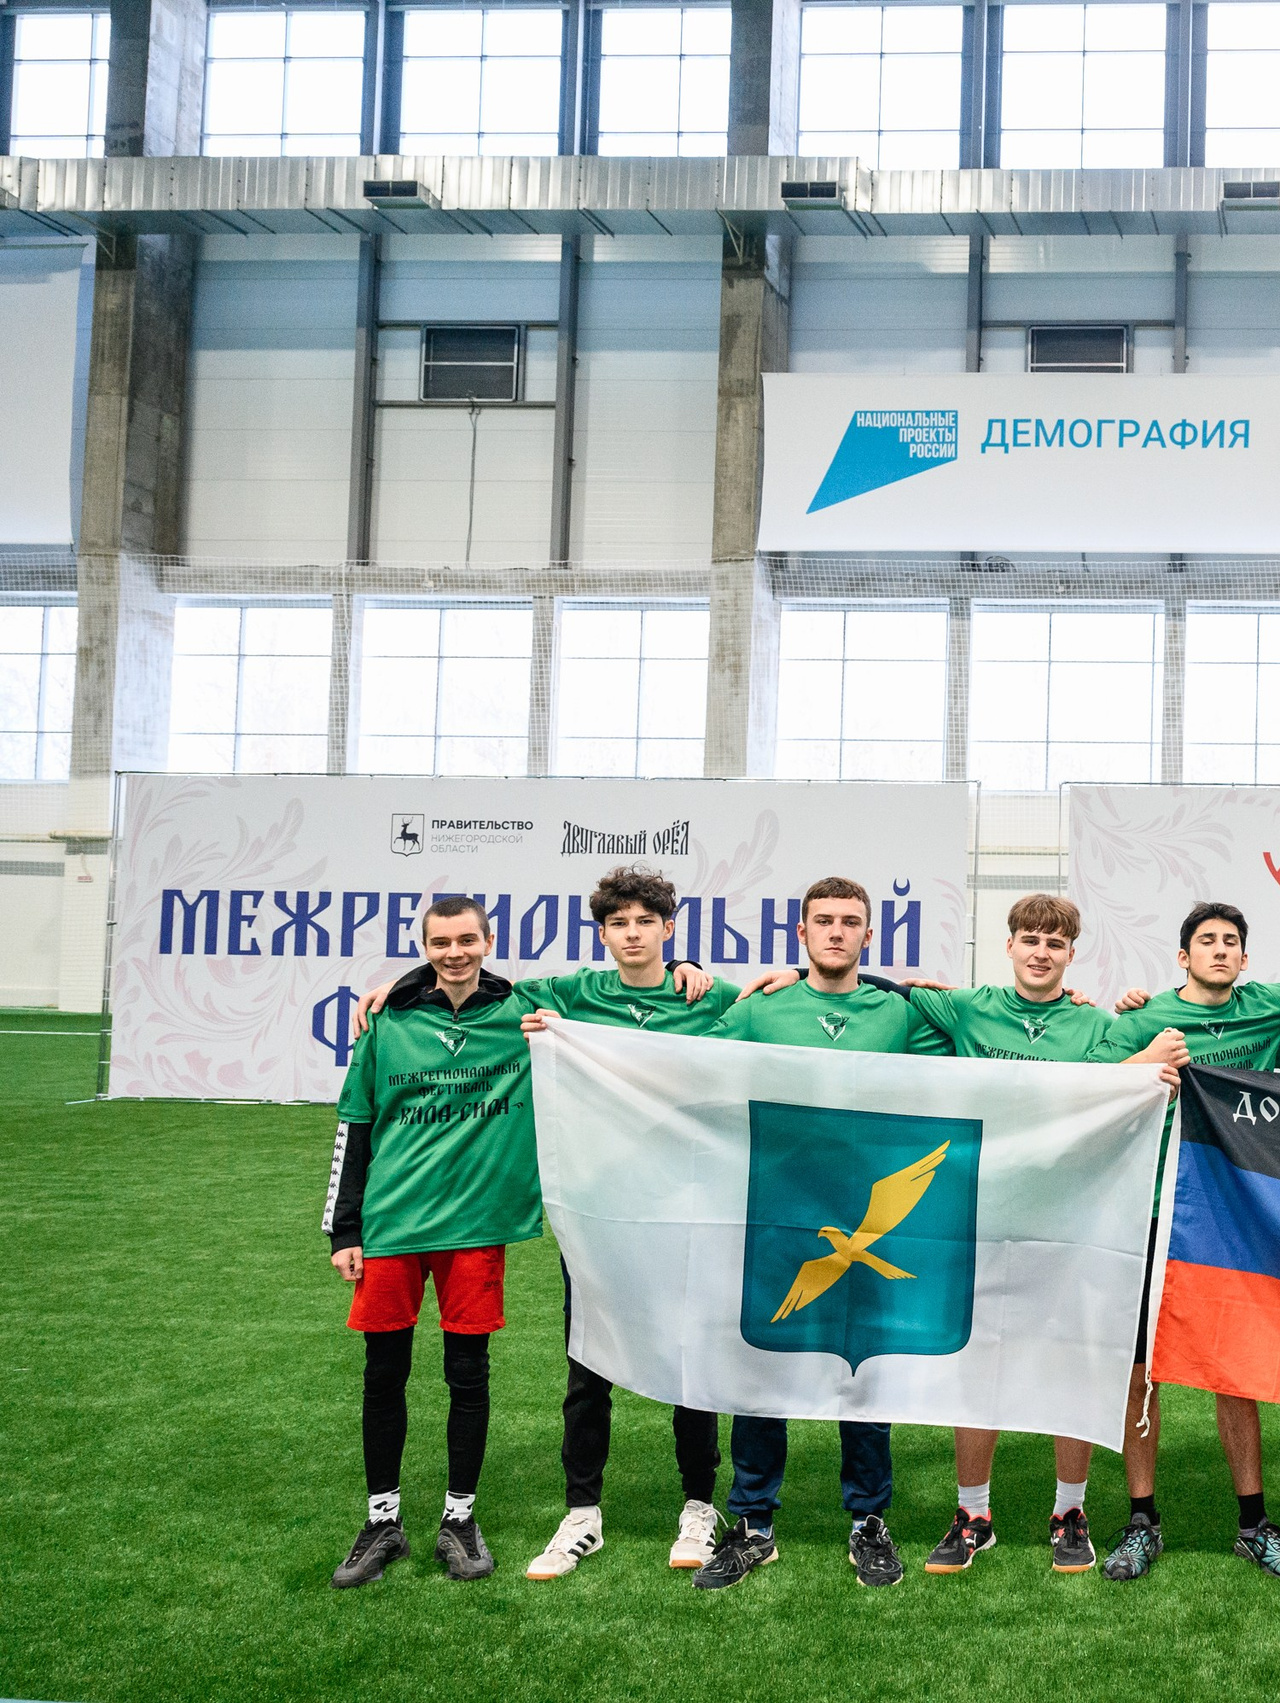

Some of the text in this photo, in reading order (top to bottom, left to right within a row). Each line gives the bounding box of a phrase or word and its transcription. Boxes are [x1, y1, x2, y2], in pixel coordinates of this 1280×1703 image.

[856, 411, 956, 429] НАЦИОНАЛЬНЫЕ
[899, 427, 956, 443] ПРОЕКТЫ
[980, 417, 1251, 454] ДЕМОГРАФИЯ
[909, 443, 956, 459] РОССИИ
[431, 819, 534, 831] ПРАВИТЕЛЬСТВО
[430, 833, 523, 844] НИЖЕГОРОДСКОЙ
[560, 819, 690, 857] ДВУГЛАВЫЙ ОРЁЛ
[430, 844, 478, 854] ОБЛАСТИ
[159, 878, 922, 968] МЕЖРЕИОНЛЬНЙ
[1193, 1037, 1271, 1065] РЕГИОНАЛЬНЫЙ
[388, 1060, 521, 1086] МЕЖРЕГИОНАЛЬНЫЙ
[418, 1079, 493, 1098] ФЕСТИВАЛЬ
